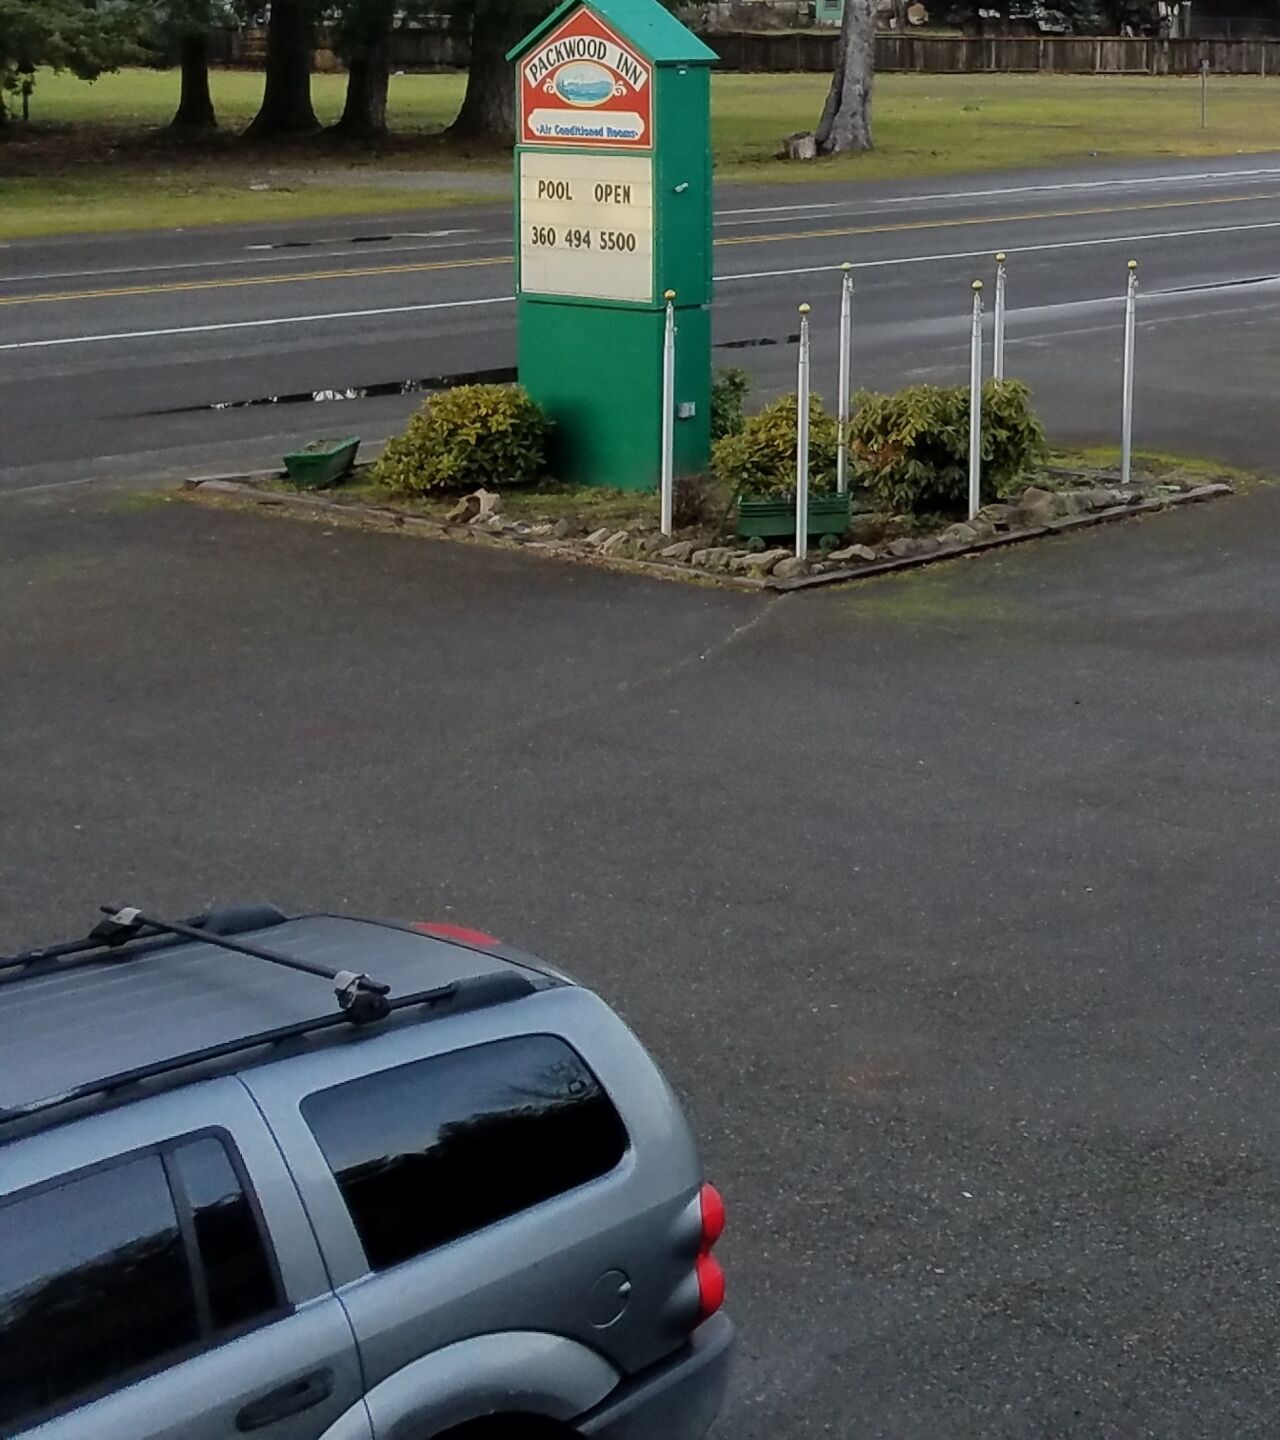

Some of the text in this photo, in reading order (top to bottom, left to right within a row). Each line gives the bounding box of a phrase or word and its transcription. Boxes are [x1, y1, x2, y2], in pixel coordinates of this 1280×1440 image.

[529, 38, 643, 85] PACKWOOD INN
[538, 179, 631, 204] POOL OPEN
[531, 225, 636, 252] 360 494 5500
